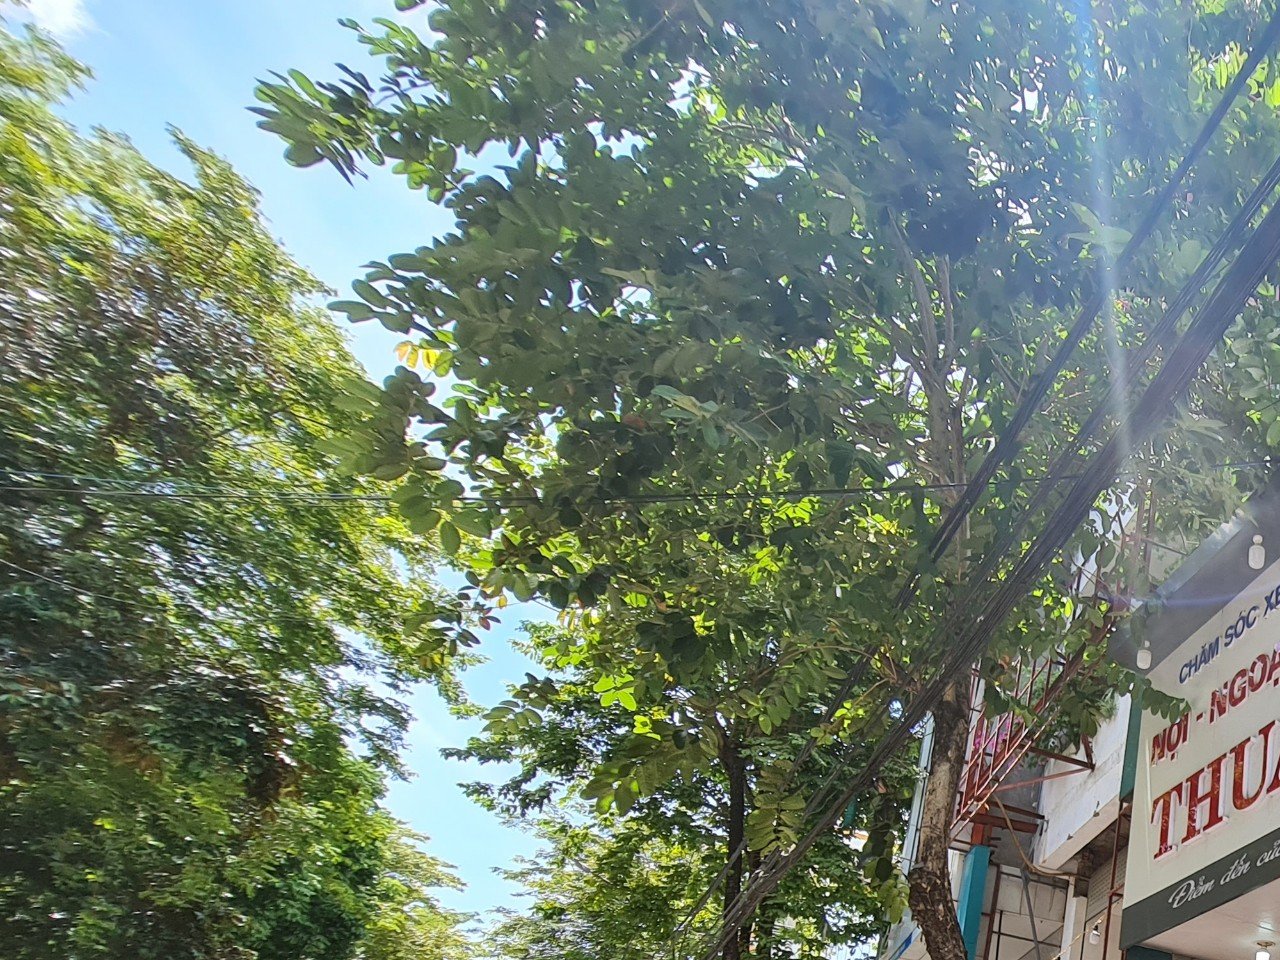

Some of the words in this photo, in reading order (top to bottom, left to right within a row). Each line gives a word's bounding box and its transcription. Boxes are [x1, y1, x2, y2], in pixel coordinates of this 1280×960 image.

[1178, 636, 1220, 685] CHĂM
[1223, 605, 1258, 649] SÓC
[1168, 875, 1215, 909] Điểm
[1220, 853, 1251, 886] đến
